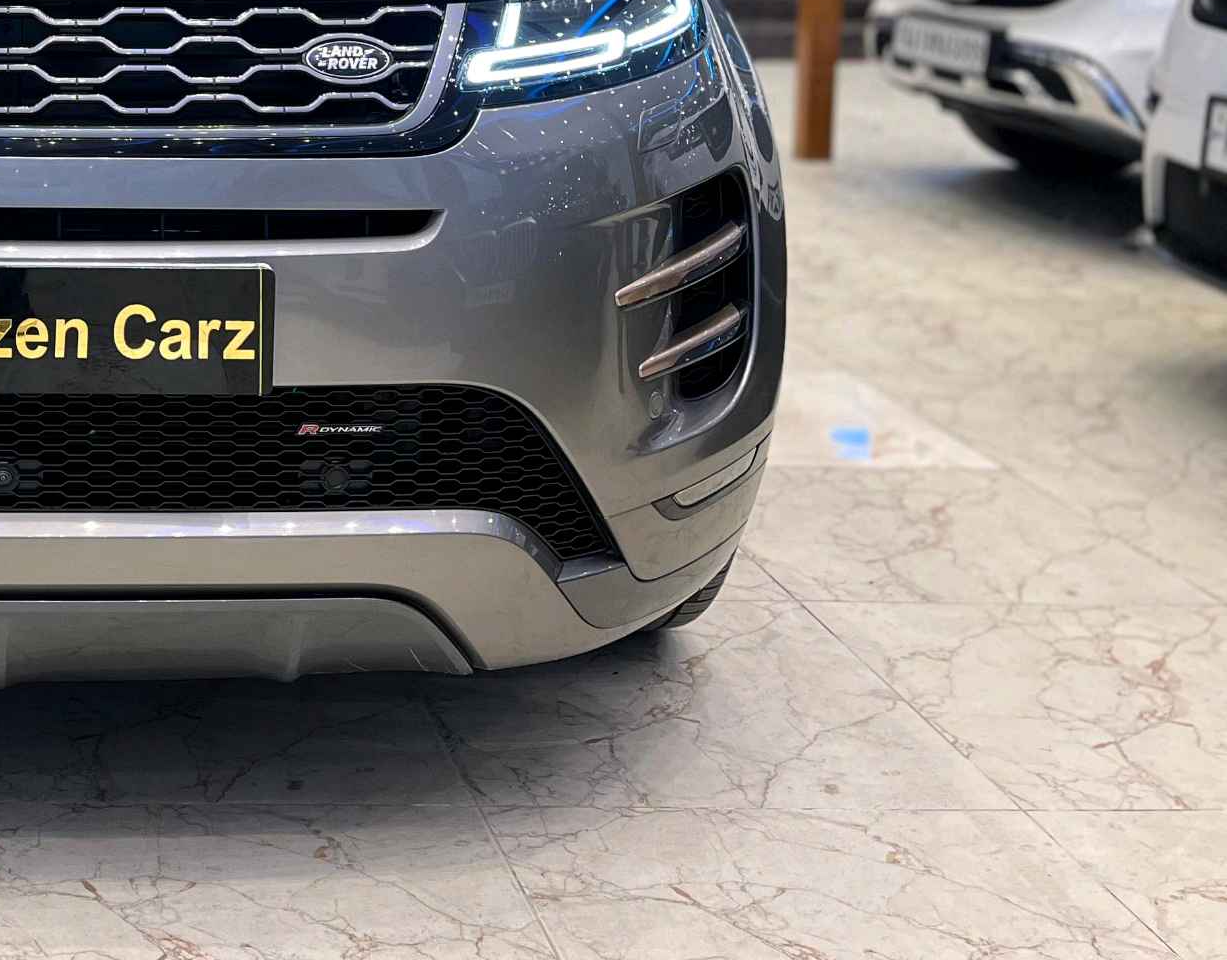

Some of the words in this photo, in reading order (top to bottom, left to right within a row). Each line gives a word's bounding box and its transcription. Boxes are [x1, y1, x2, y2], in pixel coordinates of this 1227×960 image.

[321, 44, 364, 58] LAND
[327, 58, 378, 70] ROVER
[112, 303, 256, 361] Carz
[320, 425, 383, 433] DYNAMIC
